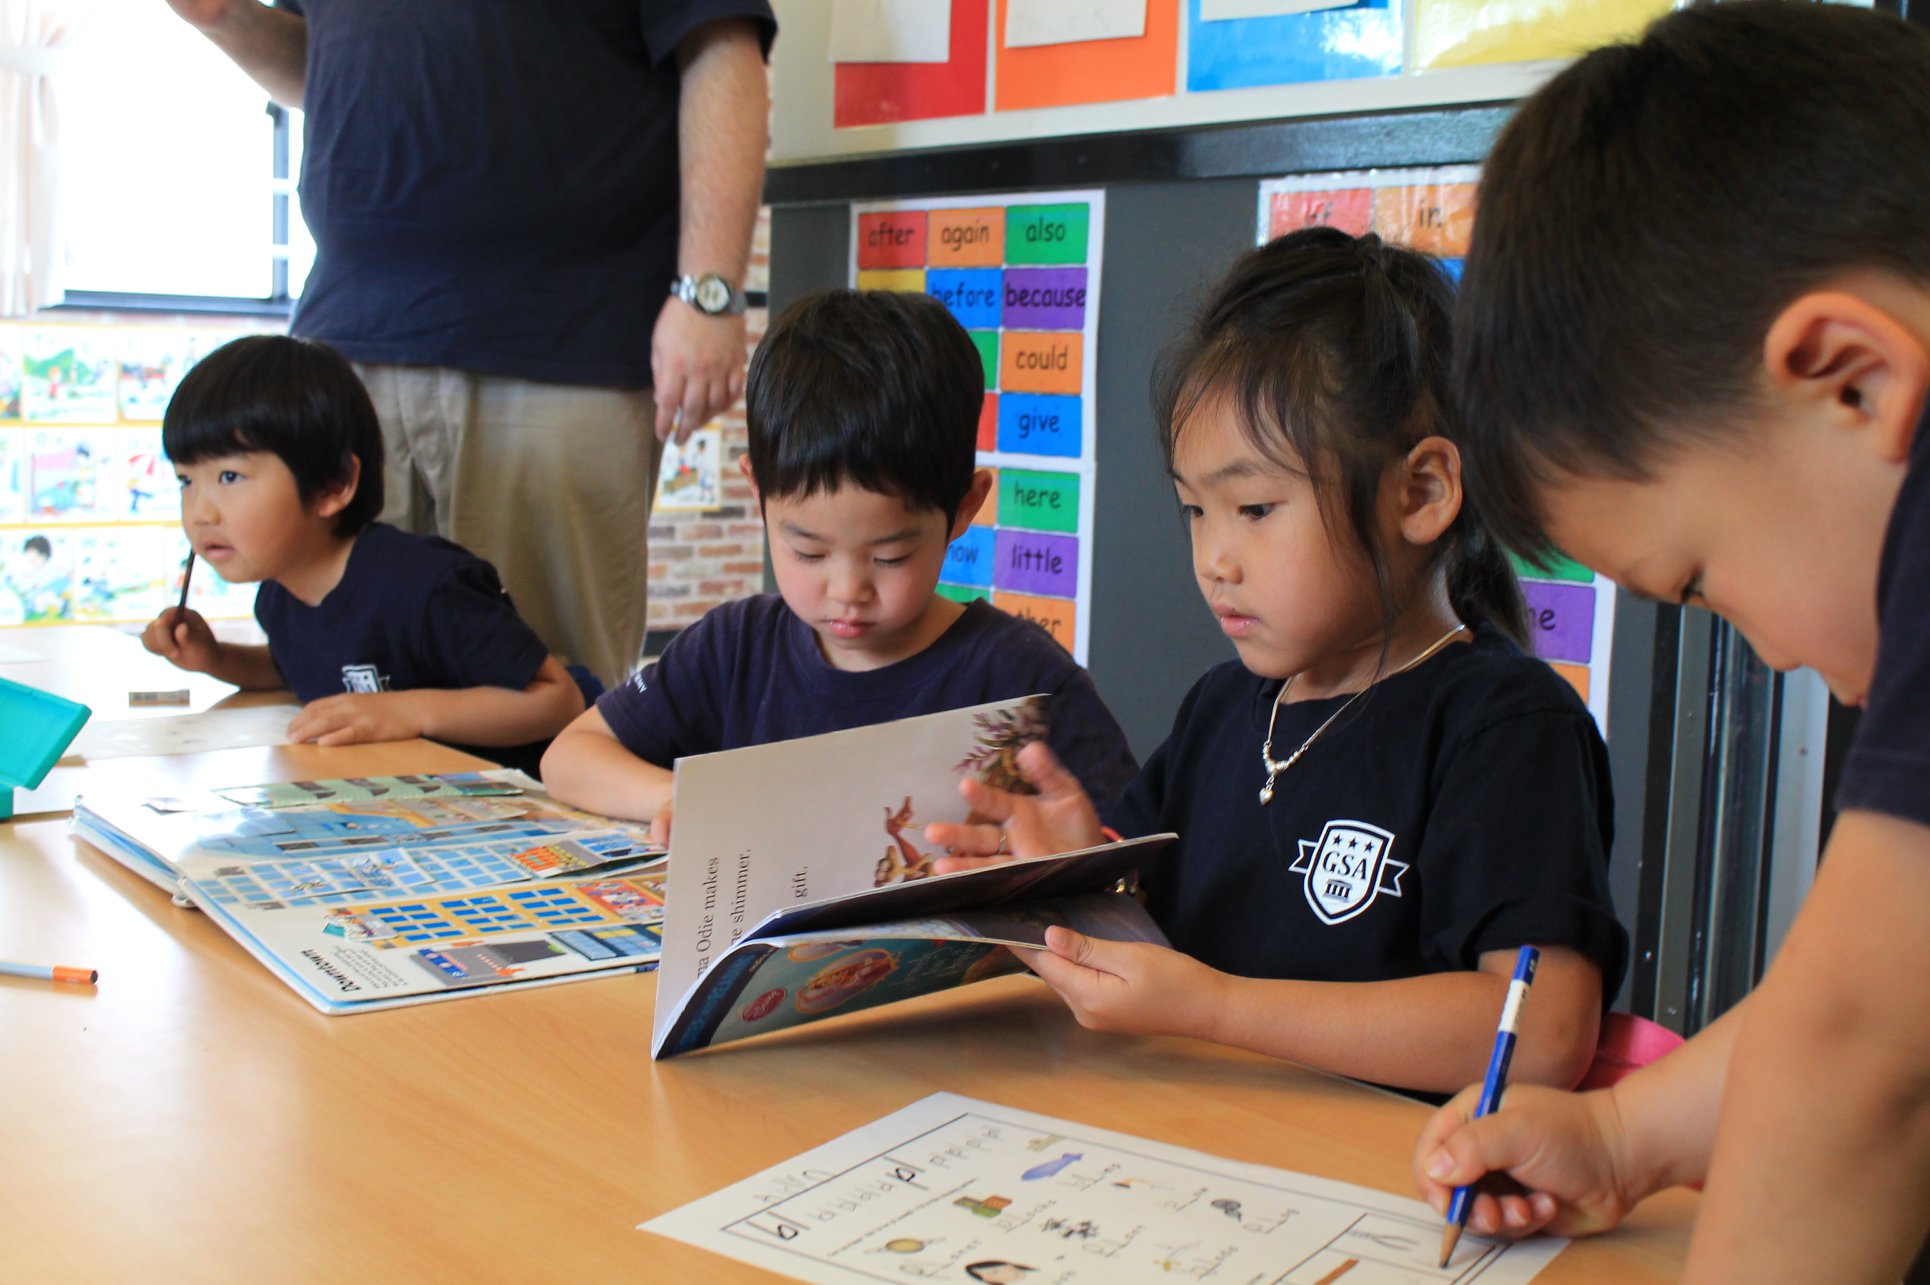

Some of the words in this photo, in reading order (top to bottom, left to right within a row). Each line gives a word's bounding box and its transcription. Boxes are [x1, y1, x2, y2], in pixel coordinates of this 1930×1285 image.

[1419, 200, 1442, 228] in
[868, 222, 915, 248] after
[941, 219, 990, 251] again
[1025, 217, 1066, 243] also
[1005, 283, 1086, 308] because
[1016, 346, 1068, 371] could
[1018, 407, 1060, 439] give
[1014, 482, 1061, 509] here
[946, 544, 979, 564] now
[1011, 544, 1063, 574] little
[1322, 850, 1368, 880] GSA
[702, 857, 720, 910] makes
[696, 914, 714, 953] Odie
